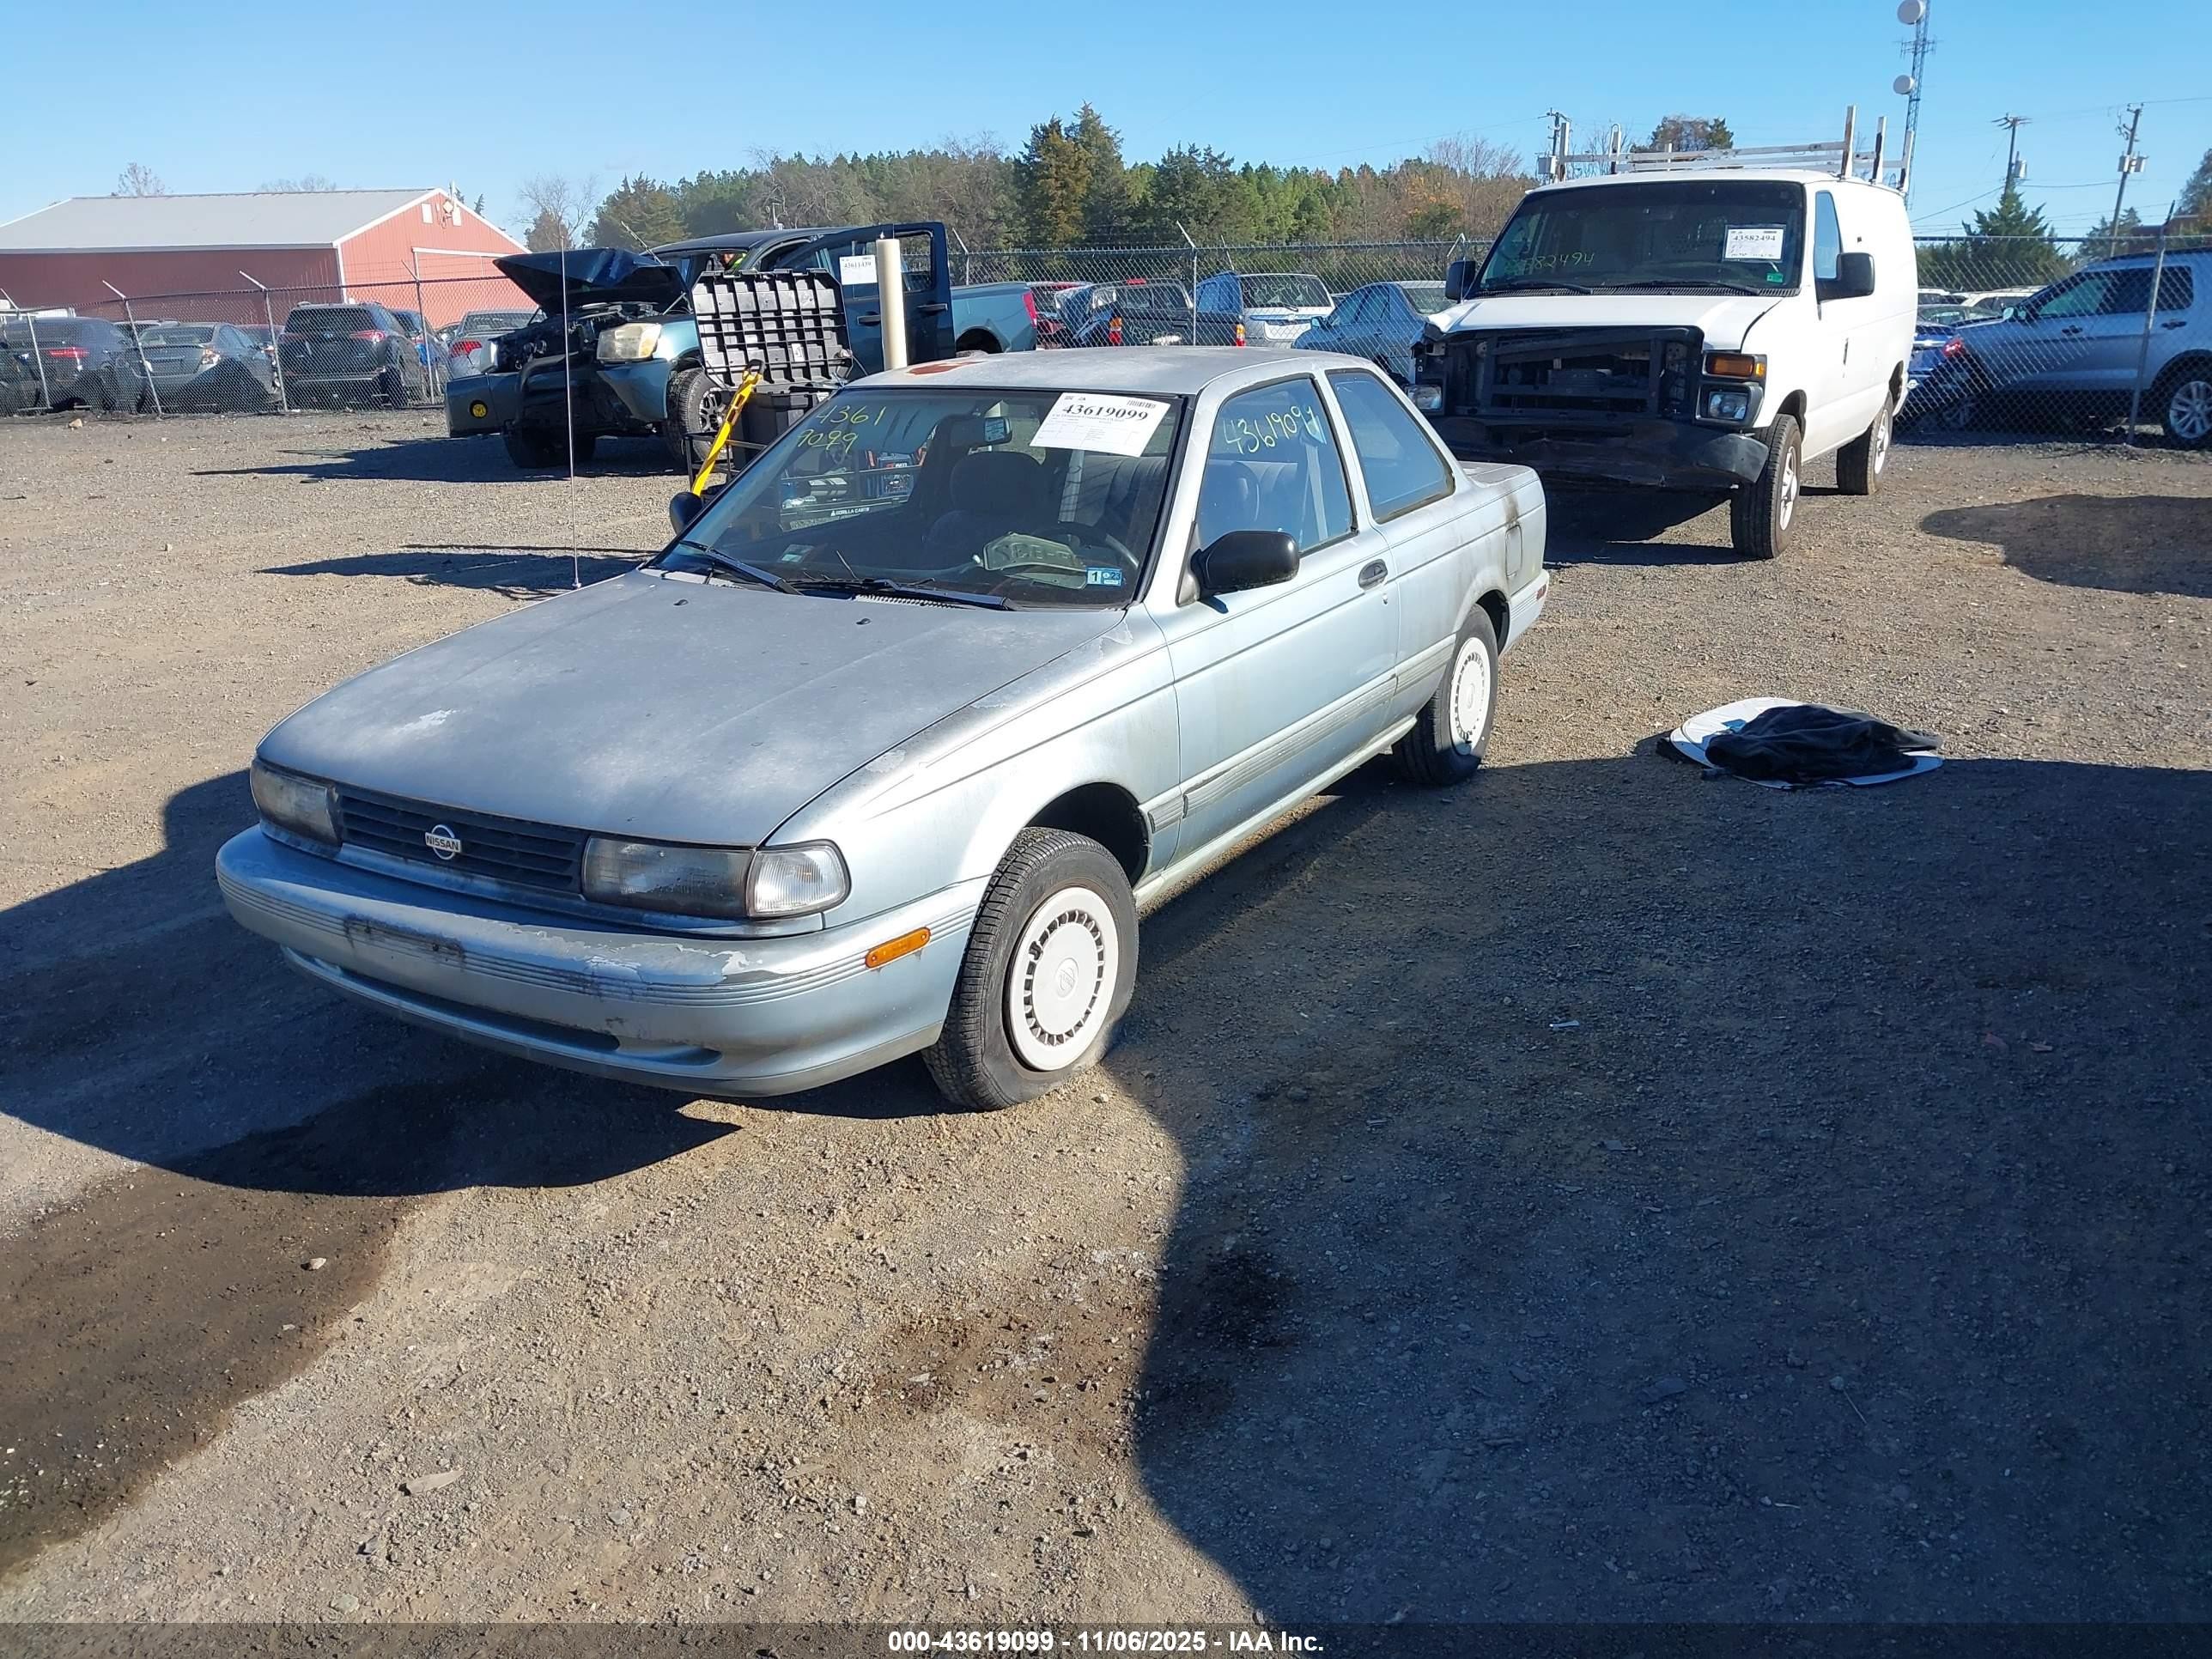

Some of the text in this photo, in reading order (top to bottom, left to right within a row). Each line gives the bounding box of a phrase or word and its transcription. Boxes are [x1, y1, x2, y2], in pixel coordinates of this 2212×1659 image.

[817, 405, 886, 426] 4361
[1062, 404, 1149, 422] 43619099
[798, 428, 859, 453] 9099
[426, 836, 459, 851] NISSAN
